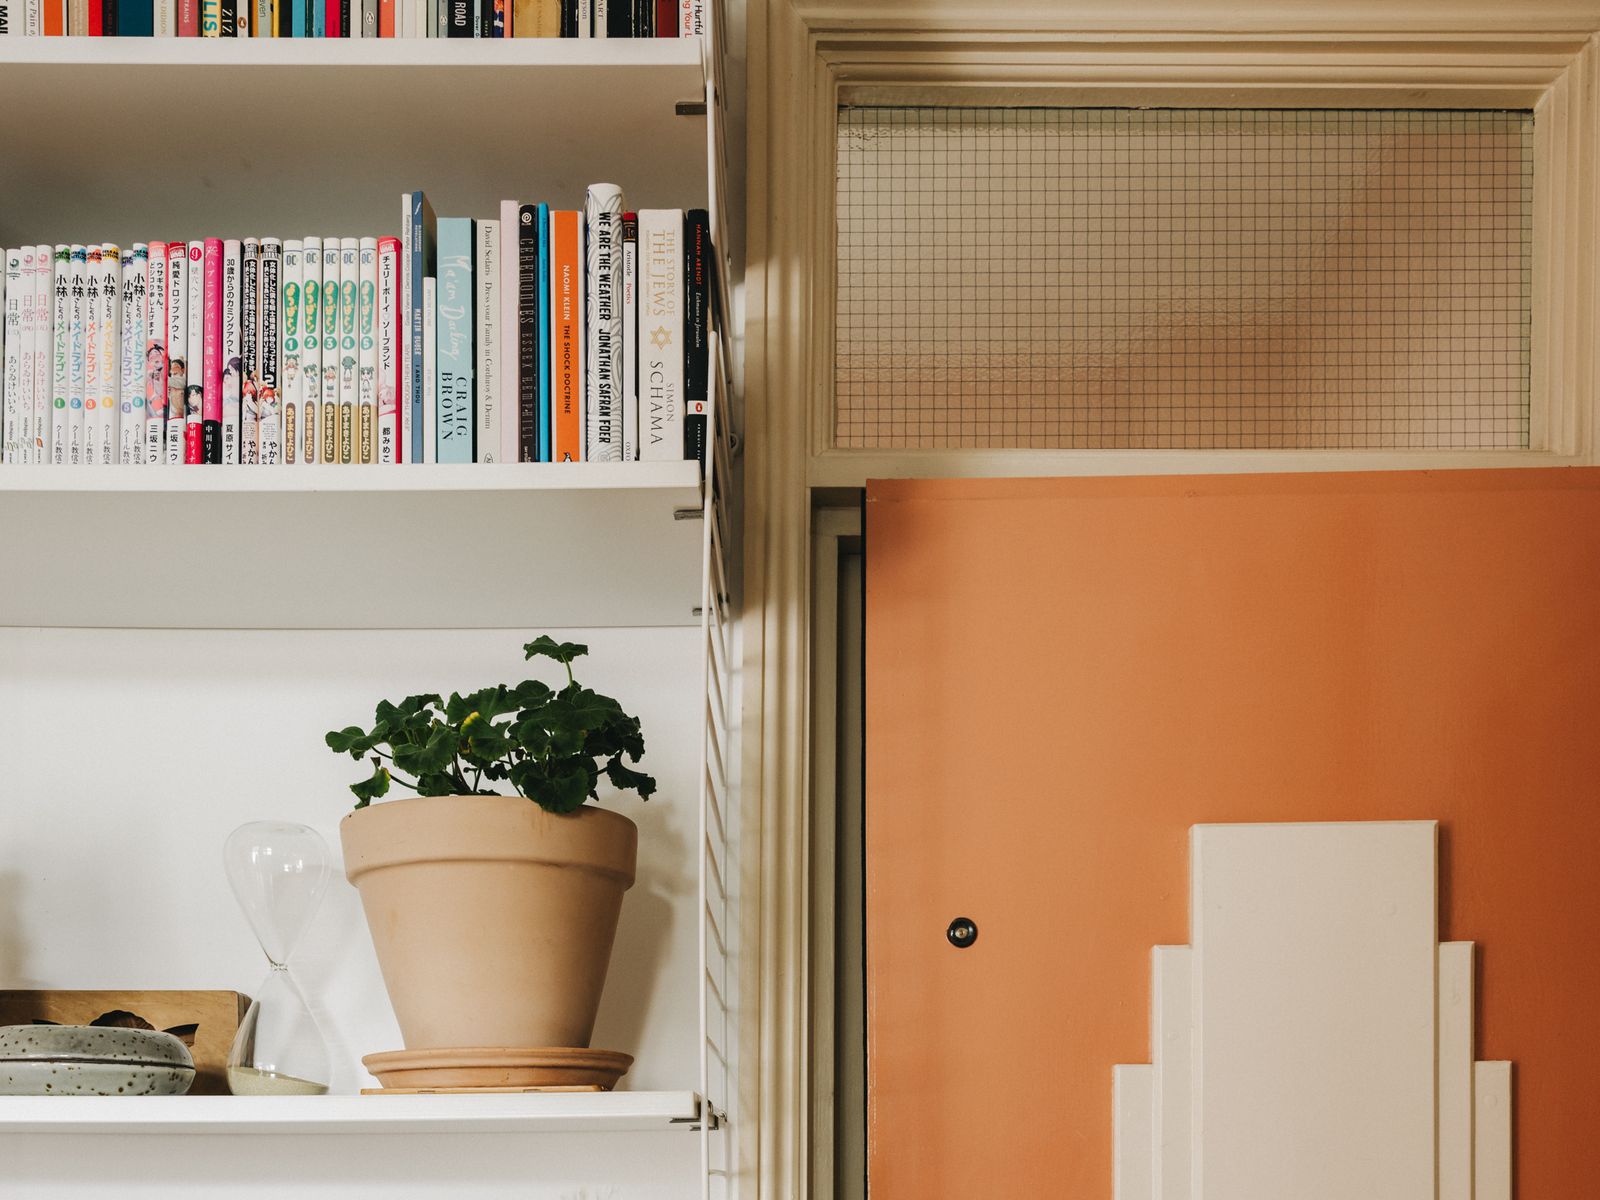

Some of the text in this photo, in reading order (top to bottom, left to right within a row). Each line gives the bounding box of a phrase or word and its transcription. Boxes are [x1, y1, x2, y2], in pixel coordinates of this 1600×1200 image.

[454, 2, 467, 26] ROAD
[684, 12, 693, 31] Your
[694, 5, 704, 35] Hurtful
[484, 250, 492, 276] Sedaris
[652, 230, 666, 316] THE JEWS
[666, 230, 675, 316] THE STORY OF
[8, 299, 20, 326] 日常
[22, 295, 34, 322] 日常
[483, 304, 491, 321] your
[483, 323, 492, 347] Family
[599, 212, 611, 443] WE ARE THE WEATHER JONATHAN SAFRAN FOER
[484, 358, 493, 393] Corduroy
[441, 372, 452, 441] BROWN
[456, 377, 468, 437] CRAIG
[485, 404, 493, 429] Denim
[650, 361, 663, 445] SCHAMA
[666, 383, 674, 422] SIMON
